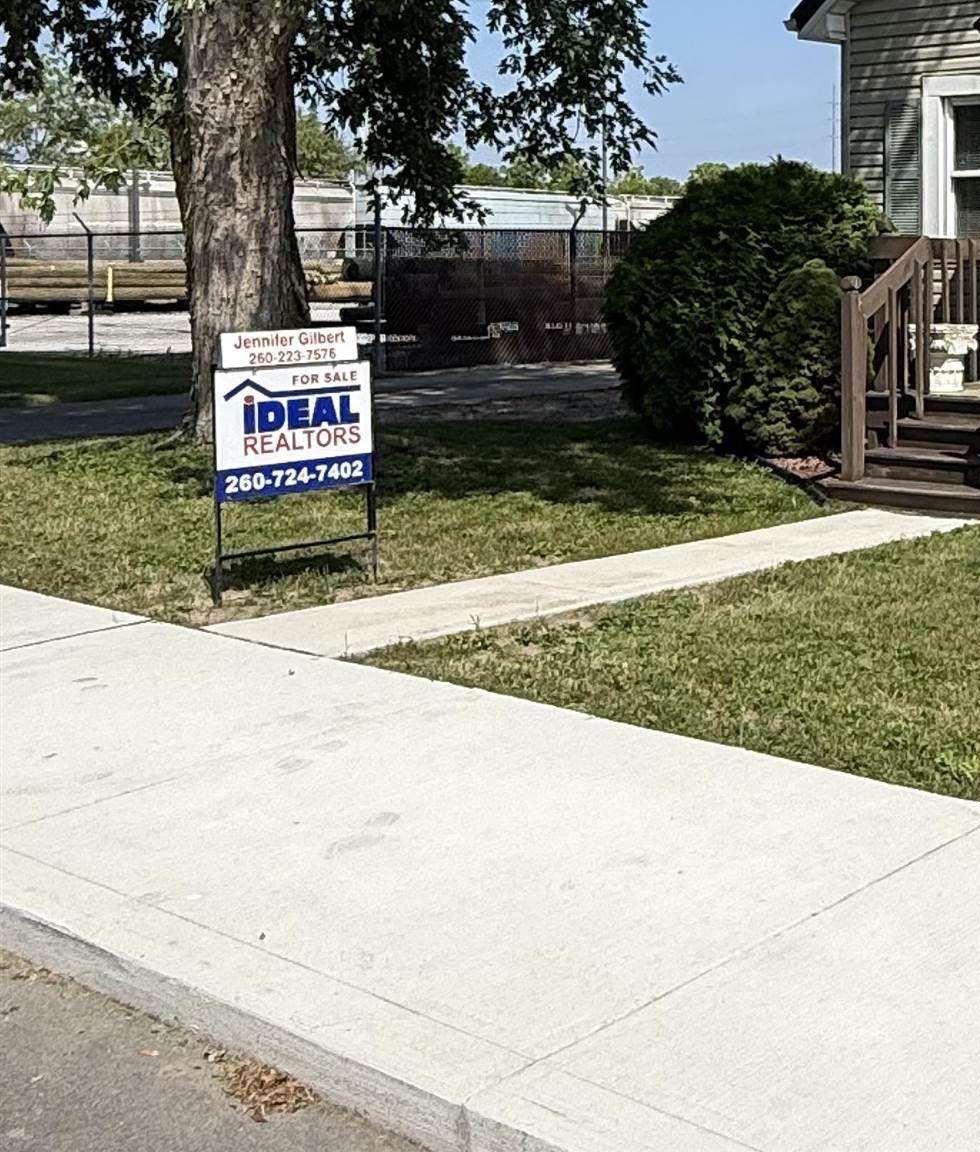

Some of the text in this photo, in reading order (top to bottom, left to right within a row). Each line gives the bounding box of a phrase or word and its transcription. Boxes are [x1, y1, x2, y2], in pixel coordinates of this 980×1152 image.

[234, 330, 345, 349] Jennifer Gilbert
[292, 371, 357, 385] FOR SALE
[244, 426, 361, 456] REALTORS
[225, 460, 363, 494] 260-724-7402
